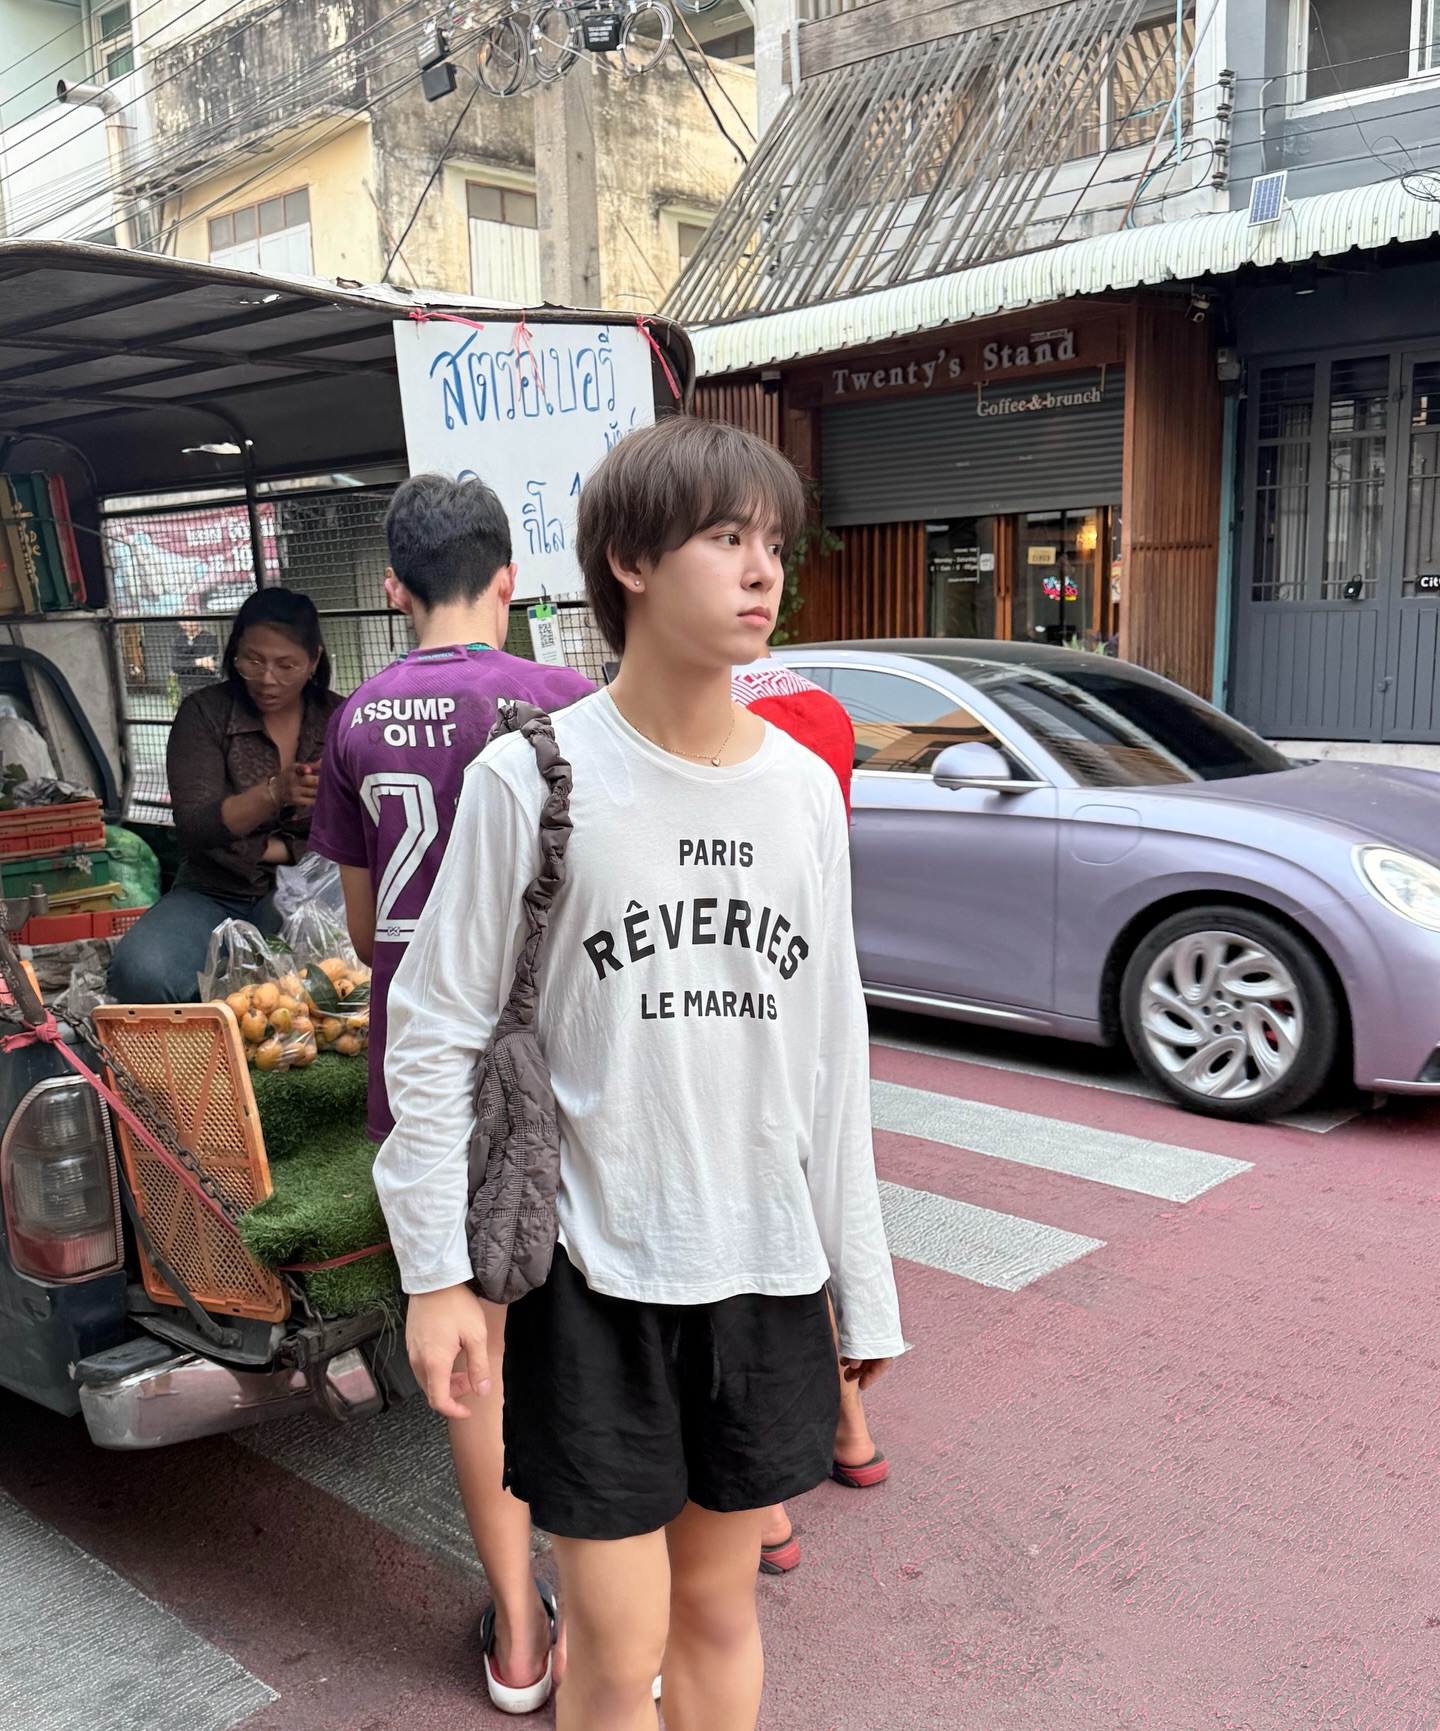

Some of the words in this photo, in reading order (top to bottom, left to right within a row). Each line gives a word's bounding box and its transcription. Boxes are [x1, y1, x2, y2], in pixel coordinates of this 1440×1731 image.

[832, 349, 961, 394] Twenty's
[983, 331, 1076, 372] Stand
[1420, 576, 1440, 588] Cit
[679, 839, 754, 868] PARIS
[583, 898, 809, 981] RÊVERIES
[641, 991, 676, 1020] LE
[683, 990, 778, 1021] MARAIS
